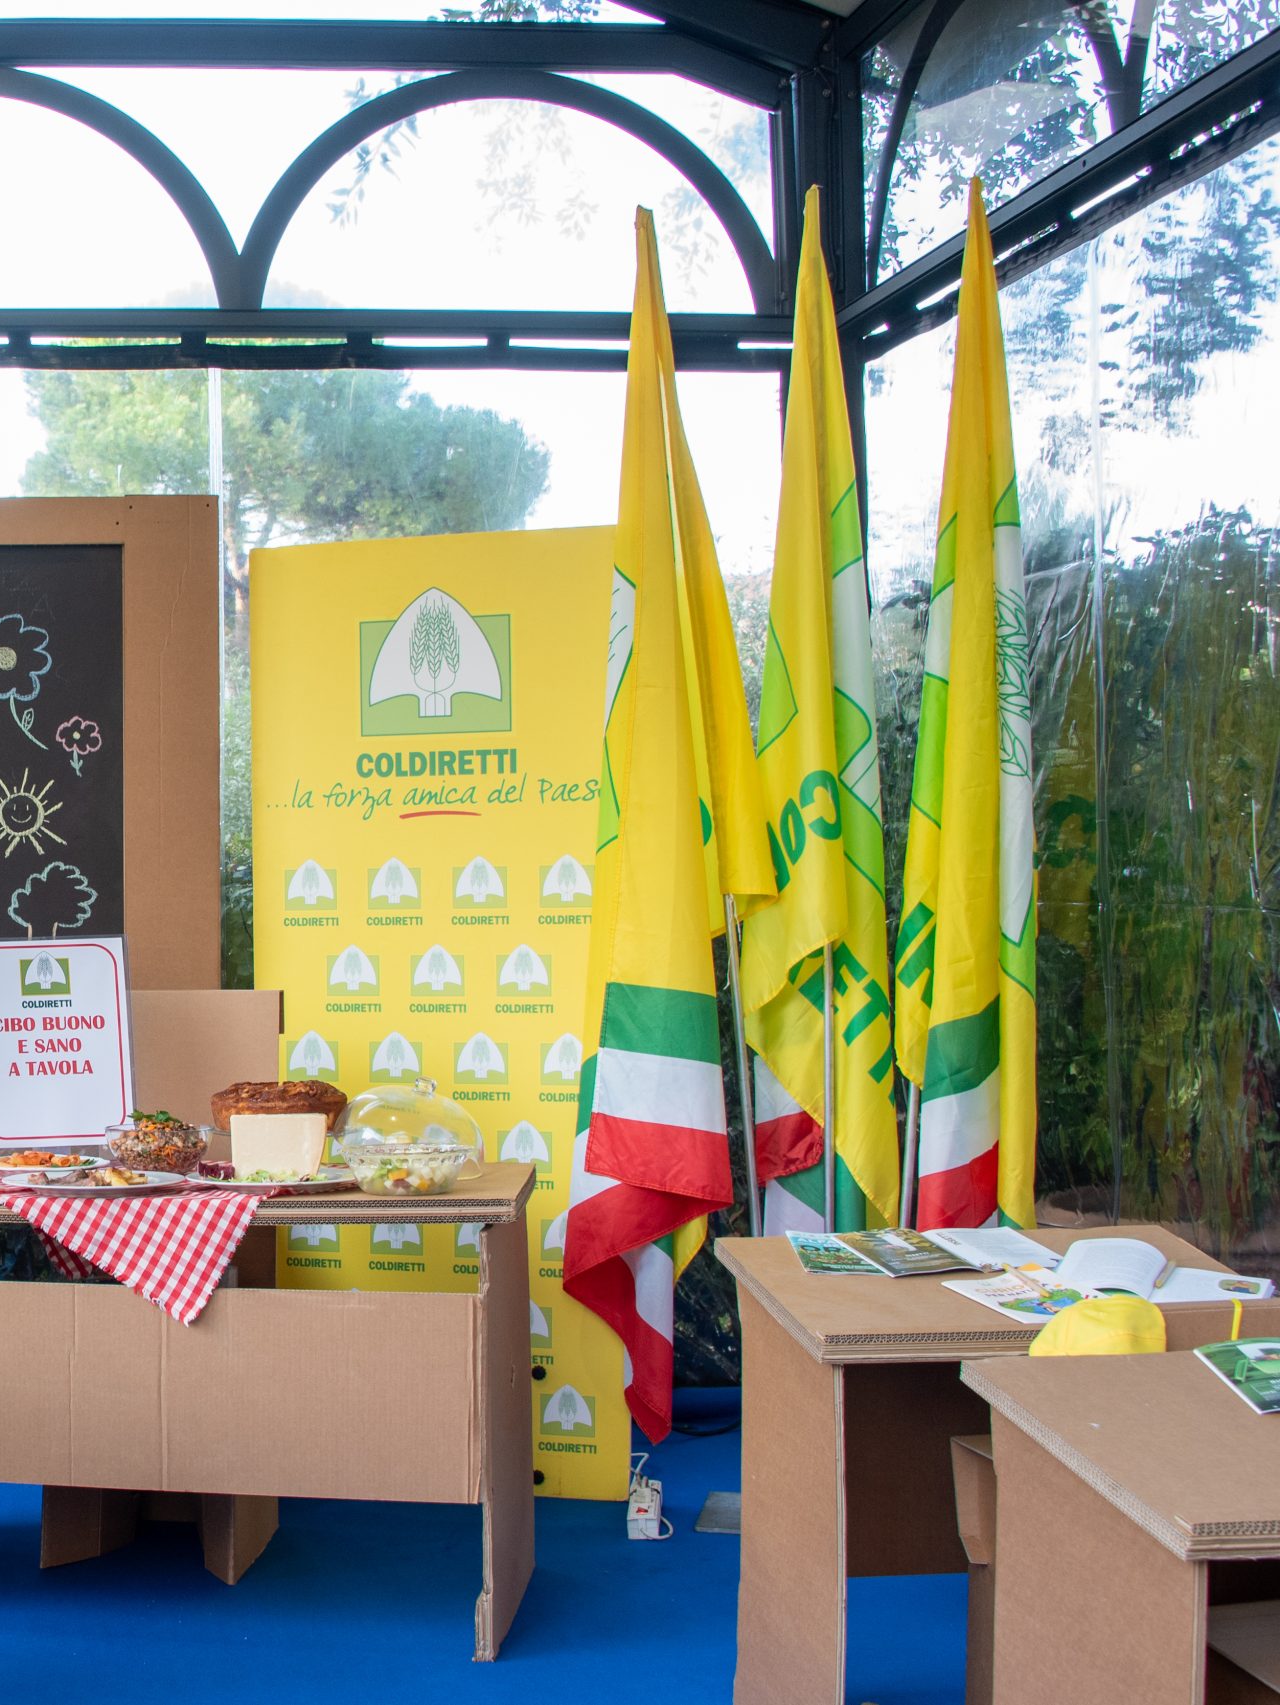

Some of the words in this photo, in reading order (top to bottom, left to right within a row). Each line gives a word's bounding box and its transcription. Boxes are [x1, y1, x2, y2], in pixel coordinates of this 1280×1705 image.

[356, 748, 518, 779] COLDIRETTI
[323, 782, 394, 821] forza
[402, 780, 478, 805] amica
[487, 772, 527, 804] del
[283, 917, 339, 927] COLDIRETTI
[366, 916, 424, 927] COLDIRETTI
[451, 915, 510, 926] COLDIRETTI
[538, 915, 592, 925] COLDIRETT
[22, 1000, 72, 1009] COLDIRETTI
[325, 1002, 382, 1014] COLDIRETTI
[409, 1002, 467, 1014] COLDIRETTI
[494, 1003, 554, 1015] COLDIRETTI
[42, 1015, 105, 1031] BUONO
[18, 1039, 29, 1054] E
[34, 1038, 82, 1054] SANO
[9, 1062, 20, 1077] A
[25, 1060, 94, 1076] TAVOLA
[452, 1090, 511, 1102] COLDIRETTI
[286, 1257, 342, 1270] COLDIRETTI
[368, 1260, 426, 1273] COLDIRETTI
[538, 1441, 598, 1455] COLDIRETTI
